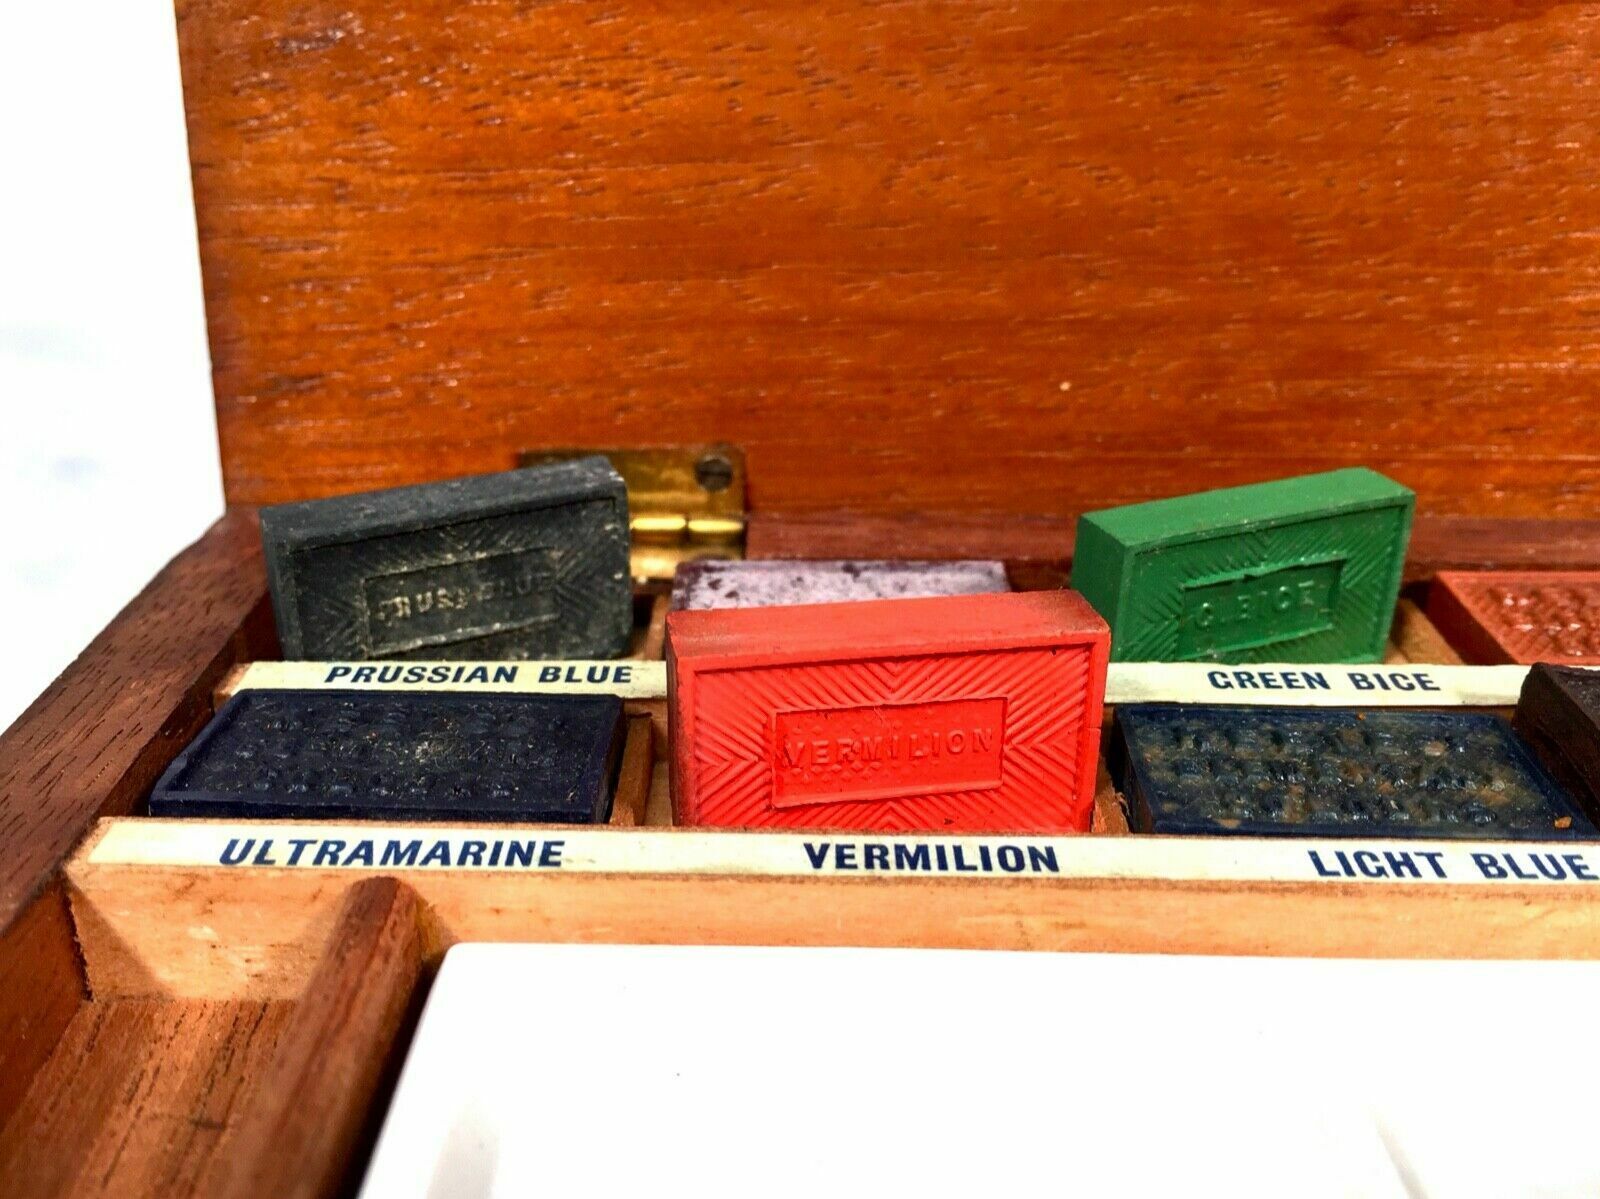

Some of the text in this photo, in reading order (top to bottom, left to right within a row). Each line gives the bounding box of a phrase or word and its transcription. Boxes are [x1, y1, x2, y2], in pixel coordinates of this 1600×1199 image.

[324, 665, 634, 684] PRUSSIAN BLUE
[1207, 670, 1442, 692] GREEN BICE
[782, 728, 994, 768] VERMILION
[219, 838, 566, 868] ULTRAMARINE
[803, 842, 1060, 873] VERMILION
[1307, 849, 1599, 881] LIGHT BLUE
